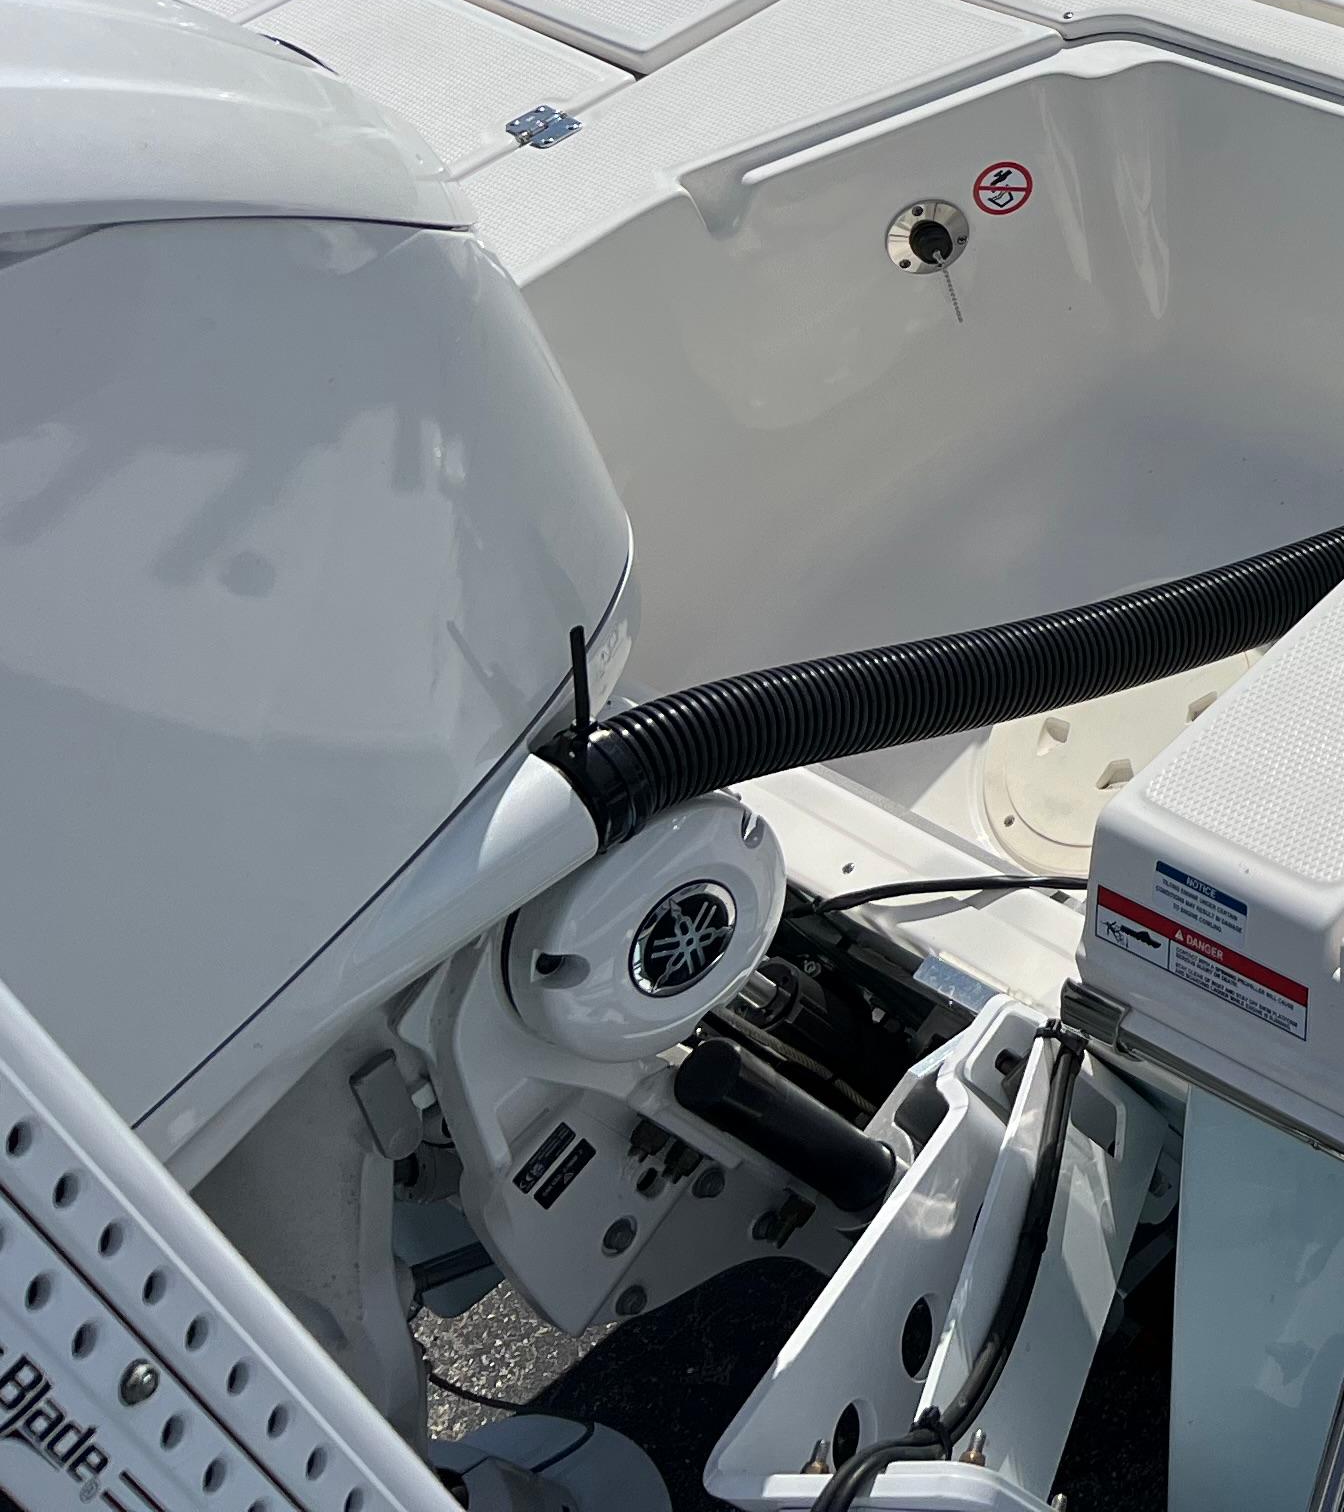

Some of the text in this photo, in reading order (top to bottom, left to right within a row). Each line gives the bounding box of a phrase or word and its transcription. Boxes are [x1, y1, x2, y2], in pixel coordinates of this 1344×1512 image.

[1186, 876, 1217, 898] NOTICE
[1186, 934, 1224, 961] DANGER
[0, 1355, 109, 1482] Blade
